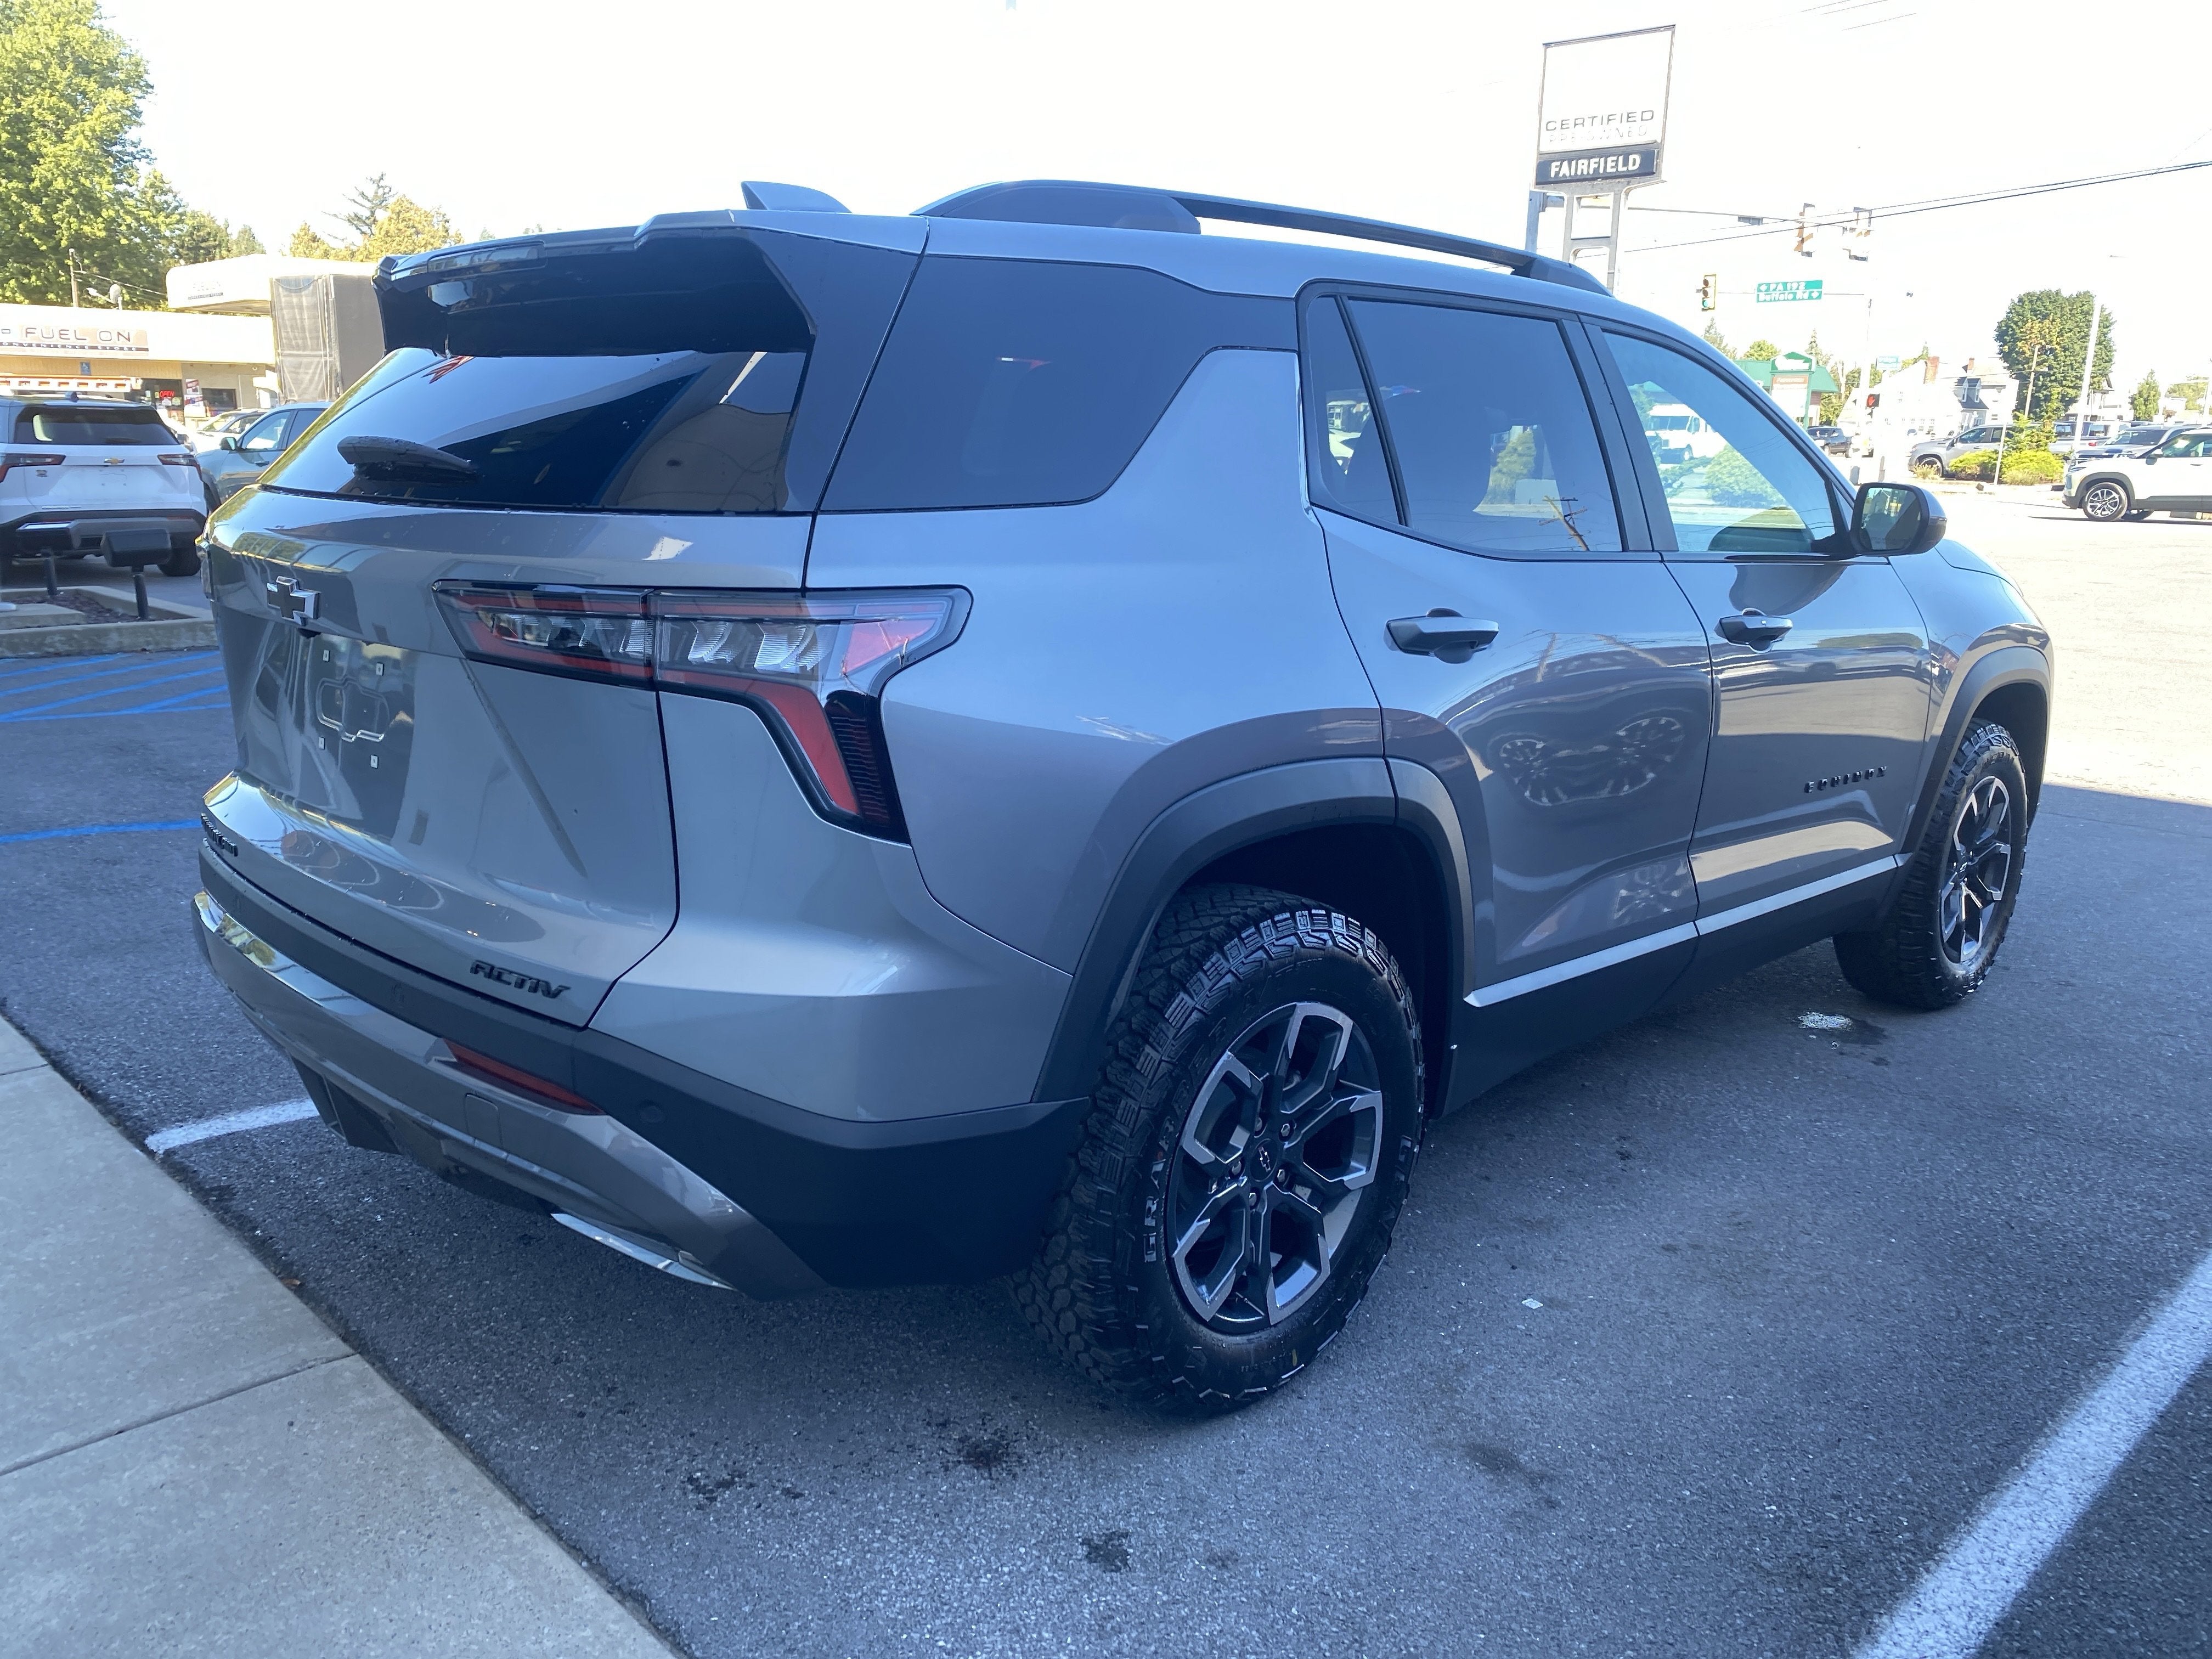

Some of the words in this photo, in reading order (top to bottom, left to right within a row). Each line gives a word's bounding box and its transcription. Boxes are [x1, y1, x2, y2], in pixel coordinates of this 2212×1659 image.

[1545, 110, 1654, 132] CERTIFIED
[1550, 154, 1641, 178] FAIRFIELD
[1769, 283, 1784, 291] PA
[1786, 281, 1806, 290] 192
[0, 341, 89, 349] ONVENIENCE
[25, 327, 87, 341] FUEL
[98, 330, 131, 342] ON
[1803, 766, 1887, 793] EQUINOX
[469, 960, 572, 999] ACTIV
